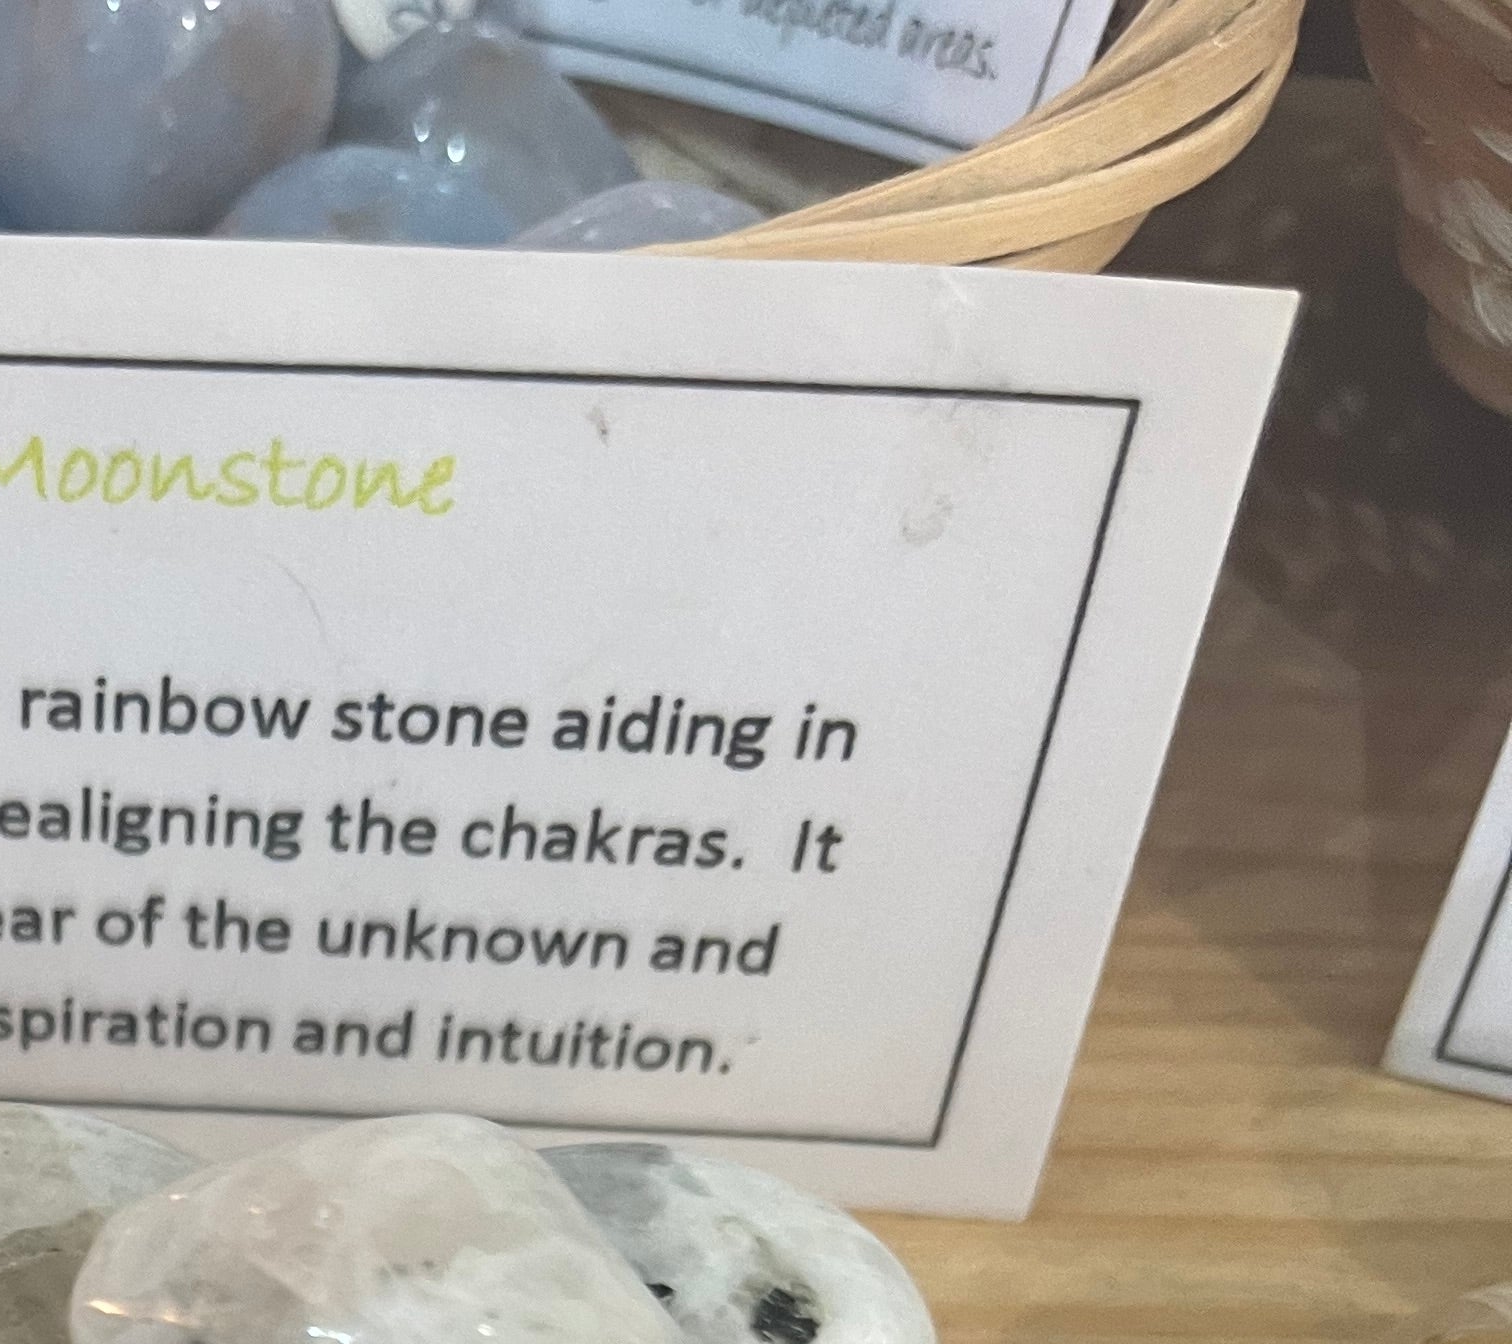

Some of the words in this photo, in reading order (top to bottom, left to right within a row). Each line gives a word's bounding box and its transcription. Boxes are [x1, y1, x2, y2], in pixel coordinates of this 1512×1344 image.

[898, 17, 999, 82] areas.
[20, 673, 312, 745] rainbow
[330, 691, 530, 749] stone
[551, 694, 774, 772] aiding
[794, 702, 858, 762] in
[325, 796, 438, 857] the
[461, 802, 744, 873] chakras.
[791, 818, 844, 874] It
[95, 893, 166, 948] of
[183, 897, 292, 954] the
[317, 906, 630, 972] unknown
[649, 922, 782, 977] and
[292, 1009, 416, 1059] and
[437, 1013, 730, 1075] intuition.
